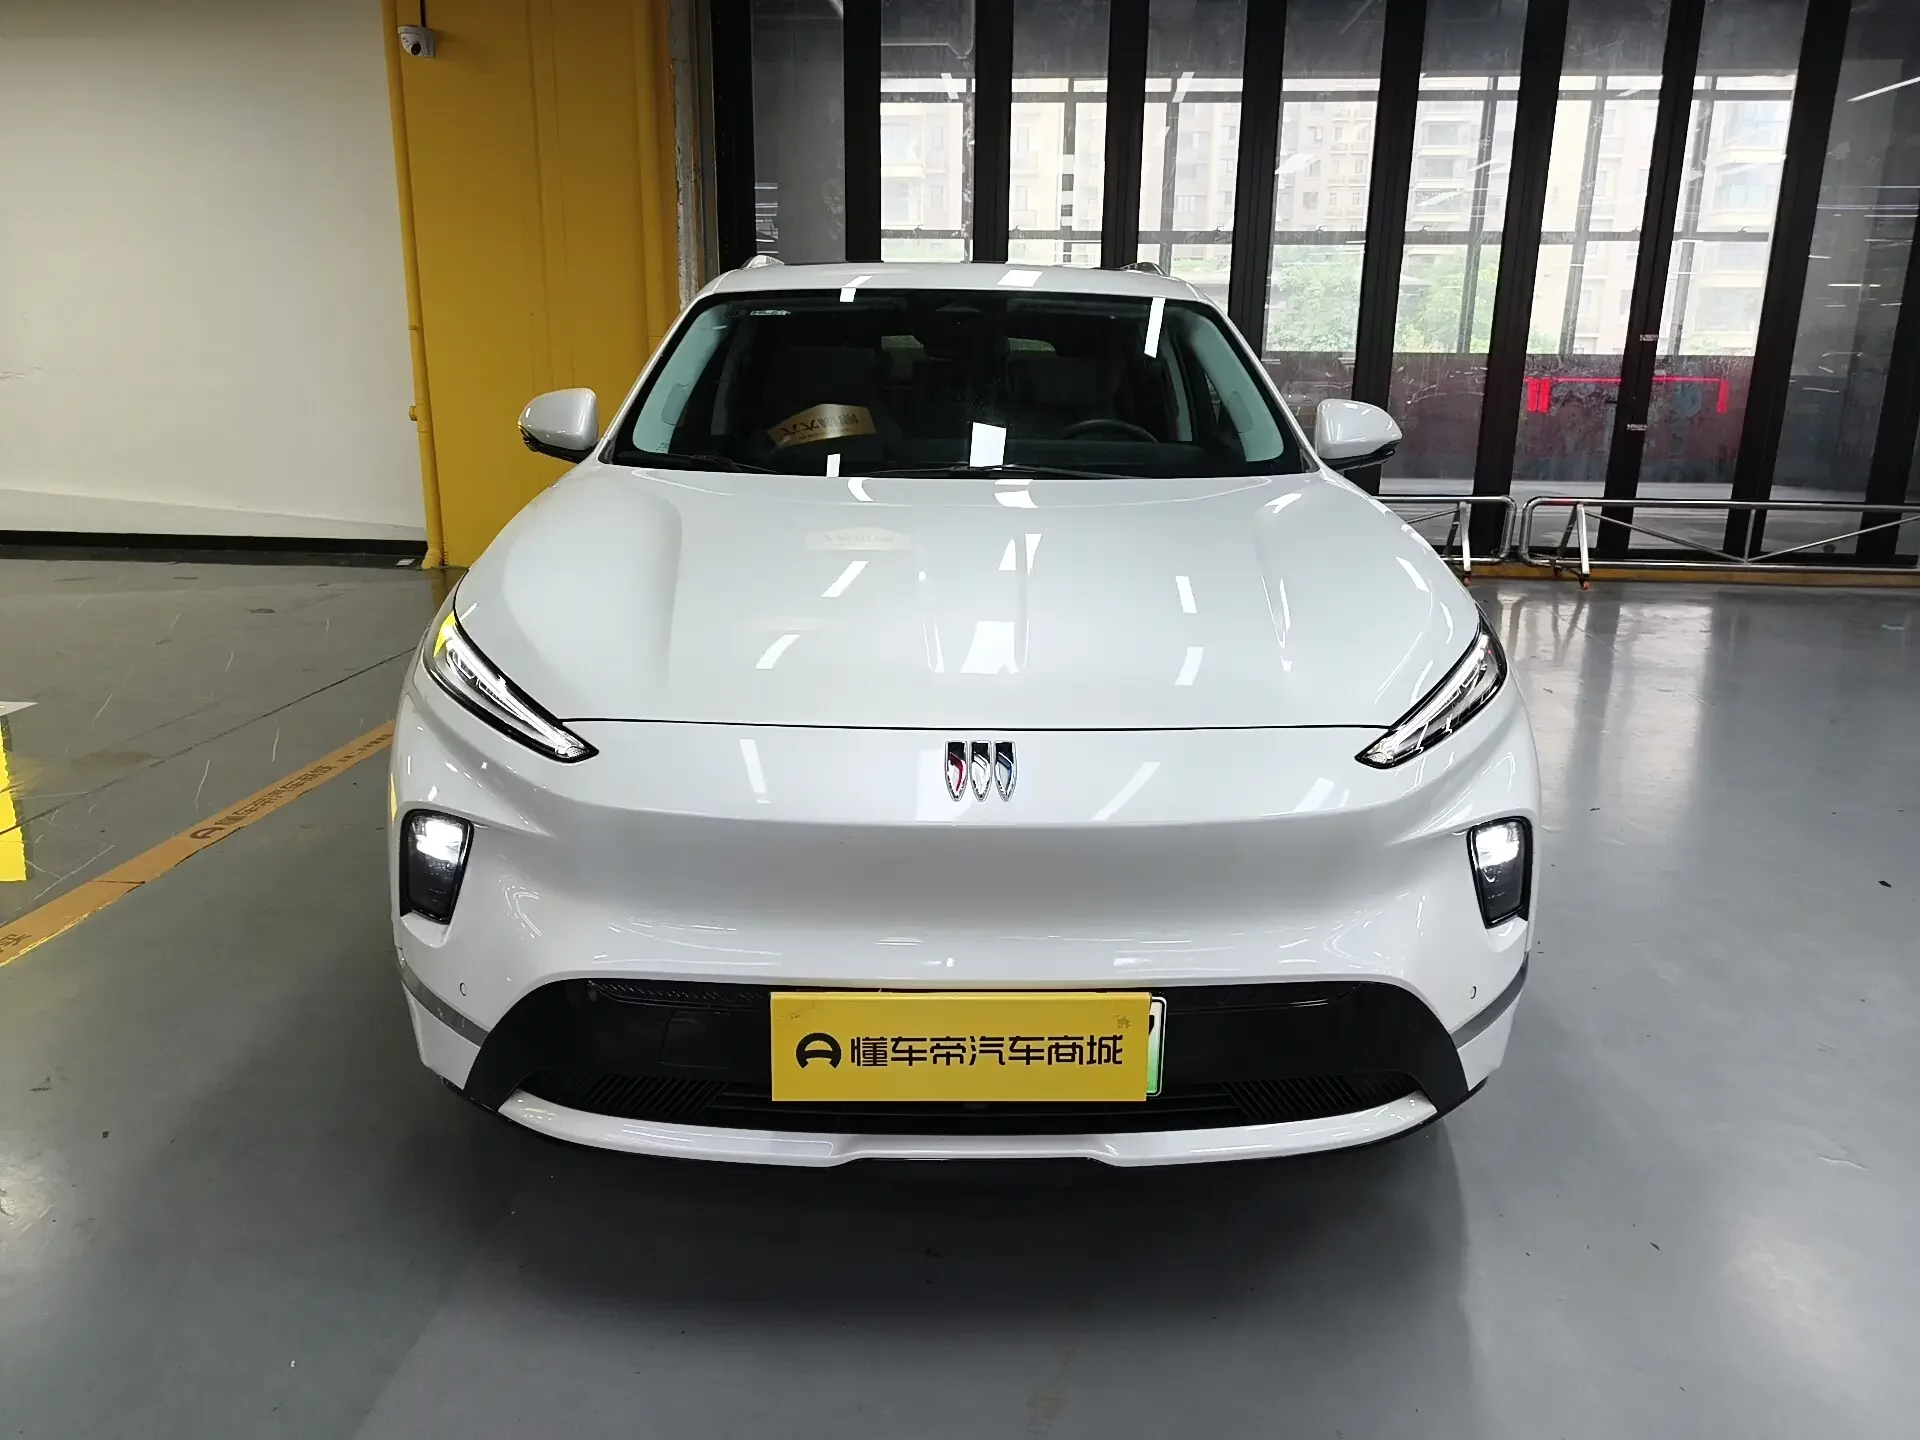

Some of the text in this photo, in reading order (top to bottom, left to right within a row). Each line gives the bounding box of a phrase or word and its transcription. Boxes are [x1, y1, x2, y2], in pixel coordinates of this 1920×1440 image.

[850, 1034, 1123, 1067] 懂车帝汽车商城
